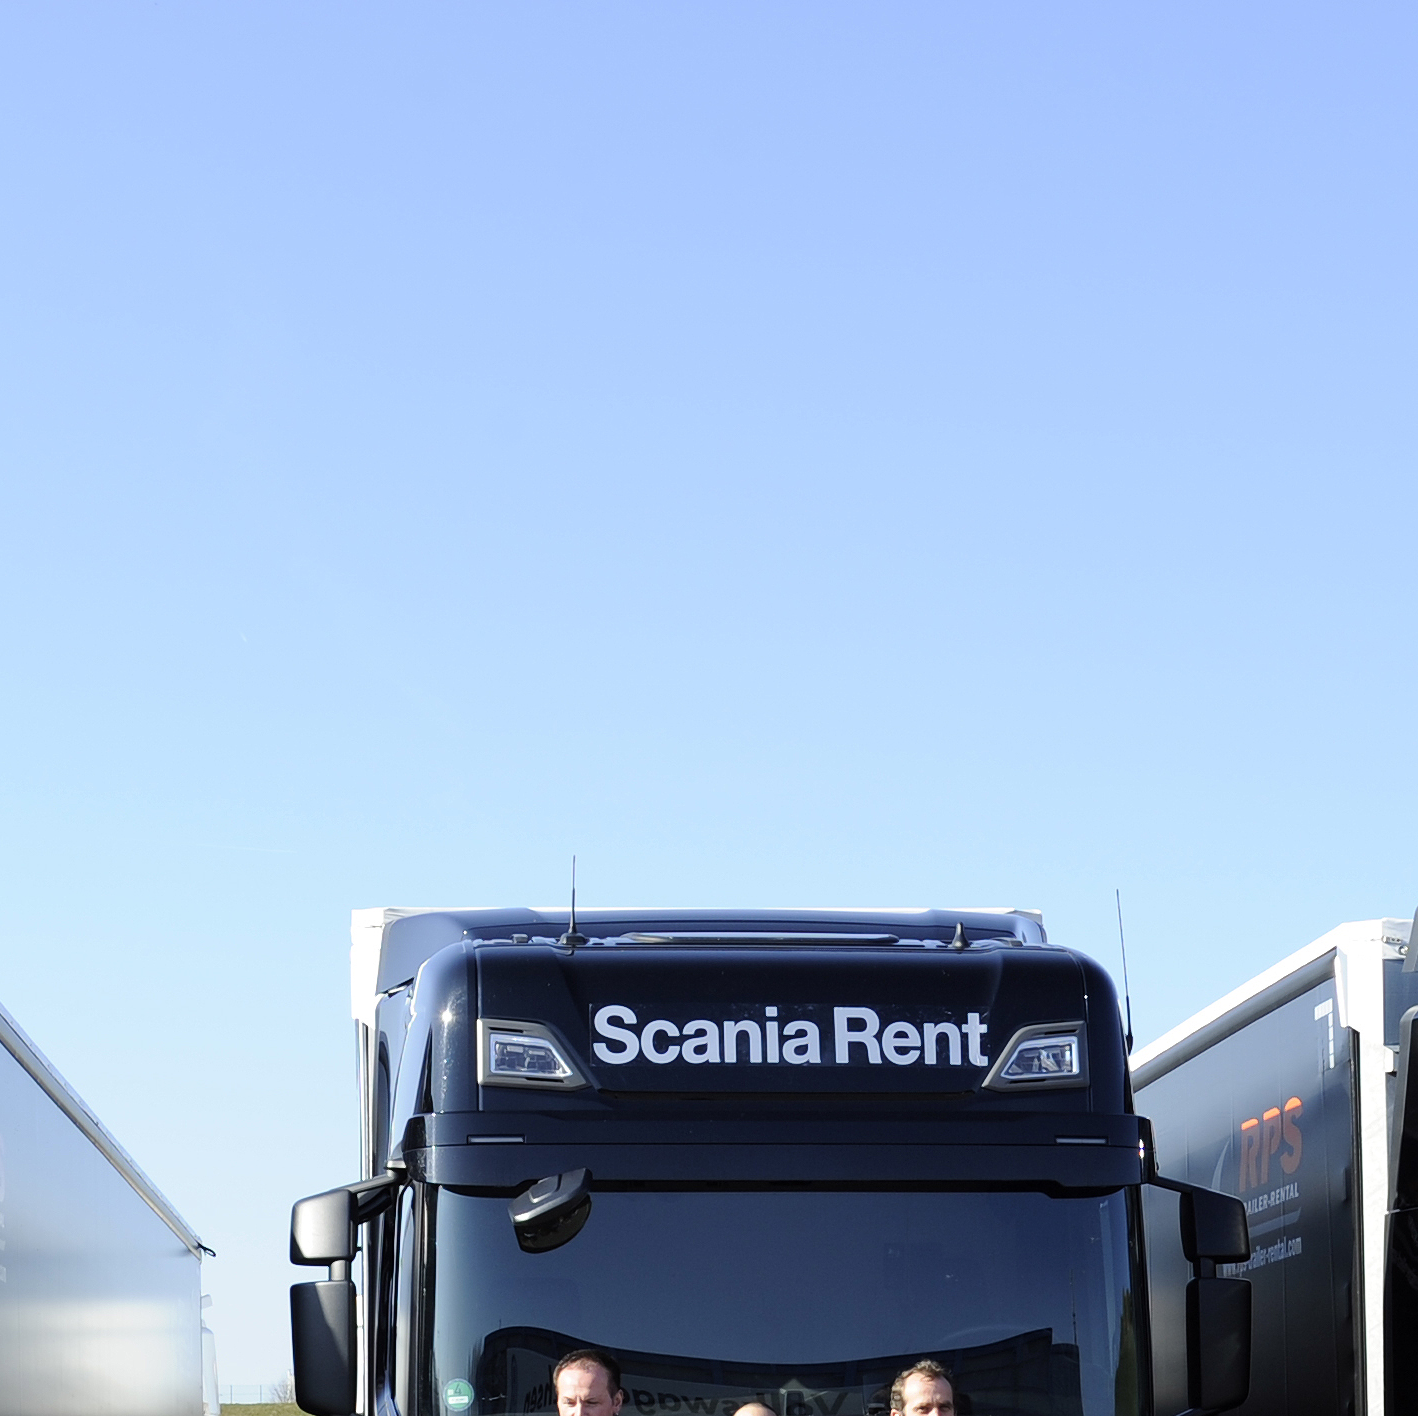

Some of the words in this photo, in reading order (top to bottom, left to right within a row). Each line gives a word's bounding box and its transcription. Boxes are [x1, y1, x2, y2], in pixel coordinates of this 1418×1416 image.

[592, 1004, 821, 1064] Scania
[833, 1006, 989, 1067] Rent
[1239, 1096, 1303, 1193] RPS
[1243, 1182, 1300, 1215] RAILER-RENTAL
[454, 1382, 462, 1396] 4
